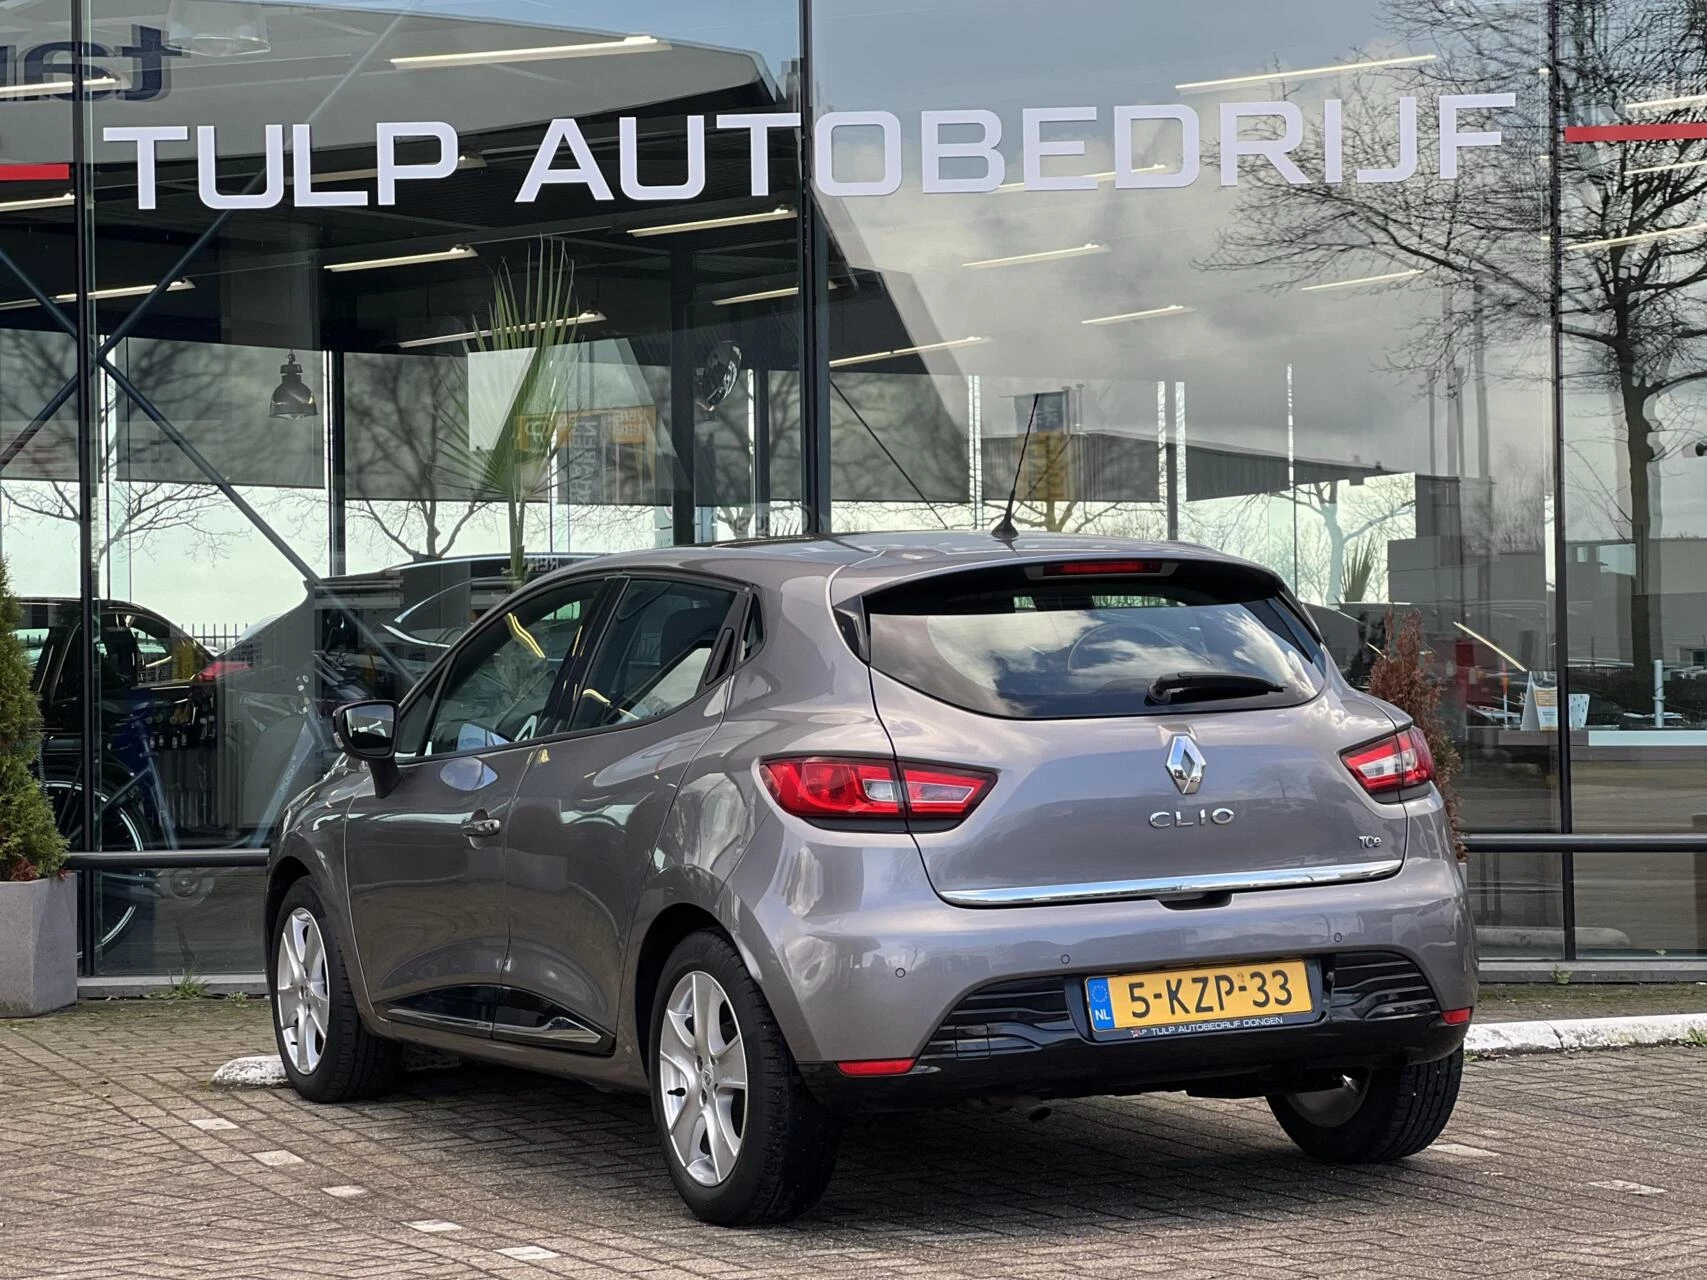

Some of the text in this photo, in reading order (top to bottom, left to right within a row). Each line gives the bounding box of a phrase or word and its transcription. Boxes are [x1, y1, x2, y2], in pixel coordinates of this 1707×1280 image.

[103, 92, 1516, 210] TULP AUTOBEDRIJF
[1149, 807, 1235, 829] CLIO
[1358, 834, 1382, 849] TCe
[1128, 969, 1293, 1019] 5-KZP-33
[1094, 1008, 1111, 1021] NL
[1151, 1016, 1284, 1036] TULP AUTOBEDRIJF DONGEN
